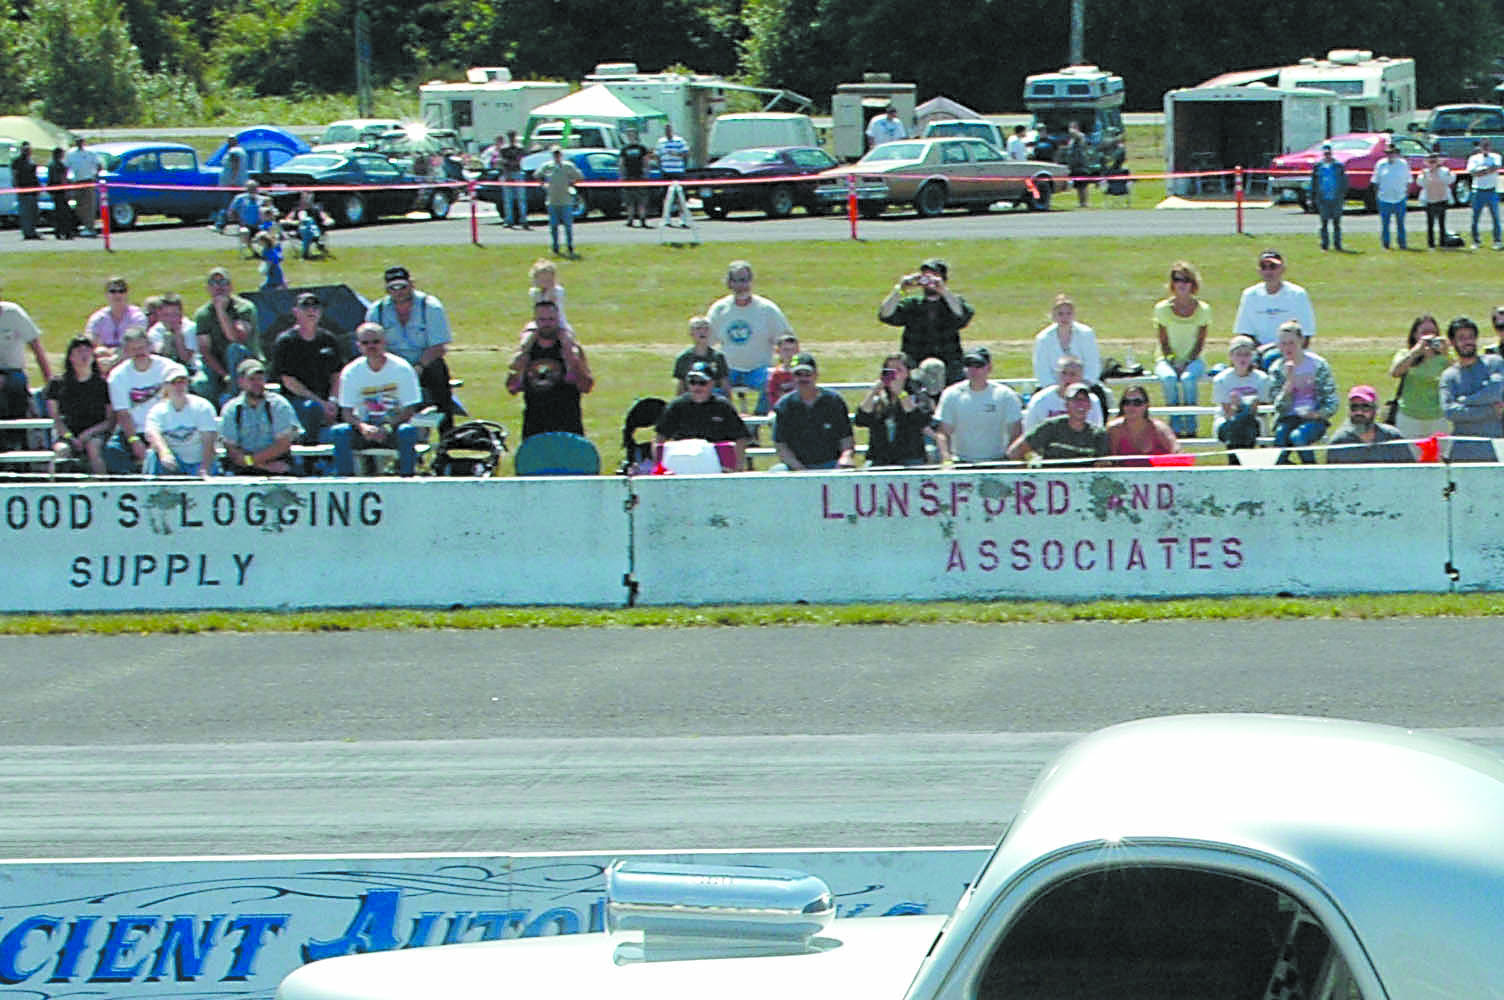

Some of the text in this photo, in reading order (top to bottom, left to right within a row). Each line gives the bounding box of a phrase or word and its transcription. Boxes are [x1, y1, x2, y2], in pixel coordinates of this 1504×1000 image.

[179, 490, 384, 528] LOGGING
[821, 479, 1071, 520] LUNSFORD
[70, 553, 255, 588] SUPPLY
[945, 536, 1245, 573] ASSOCIATES
